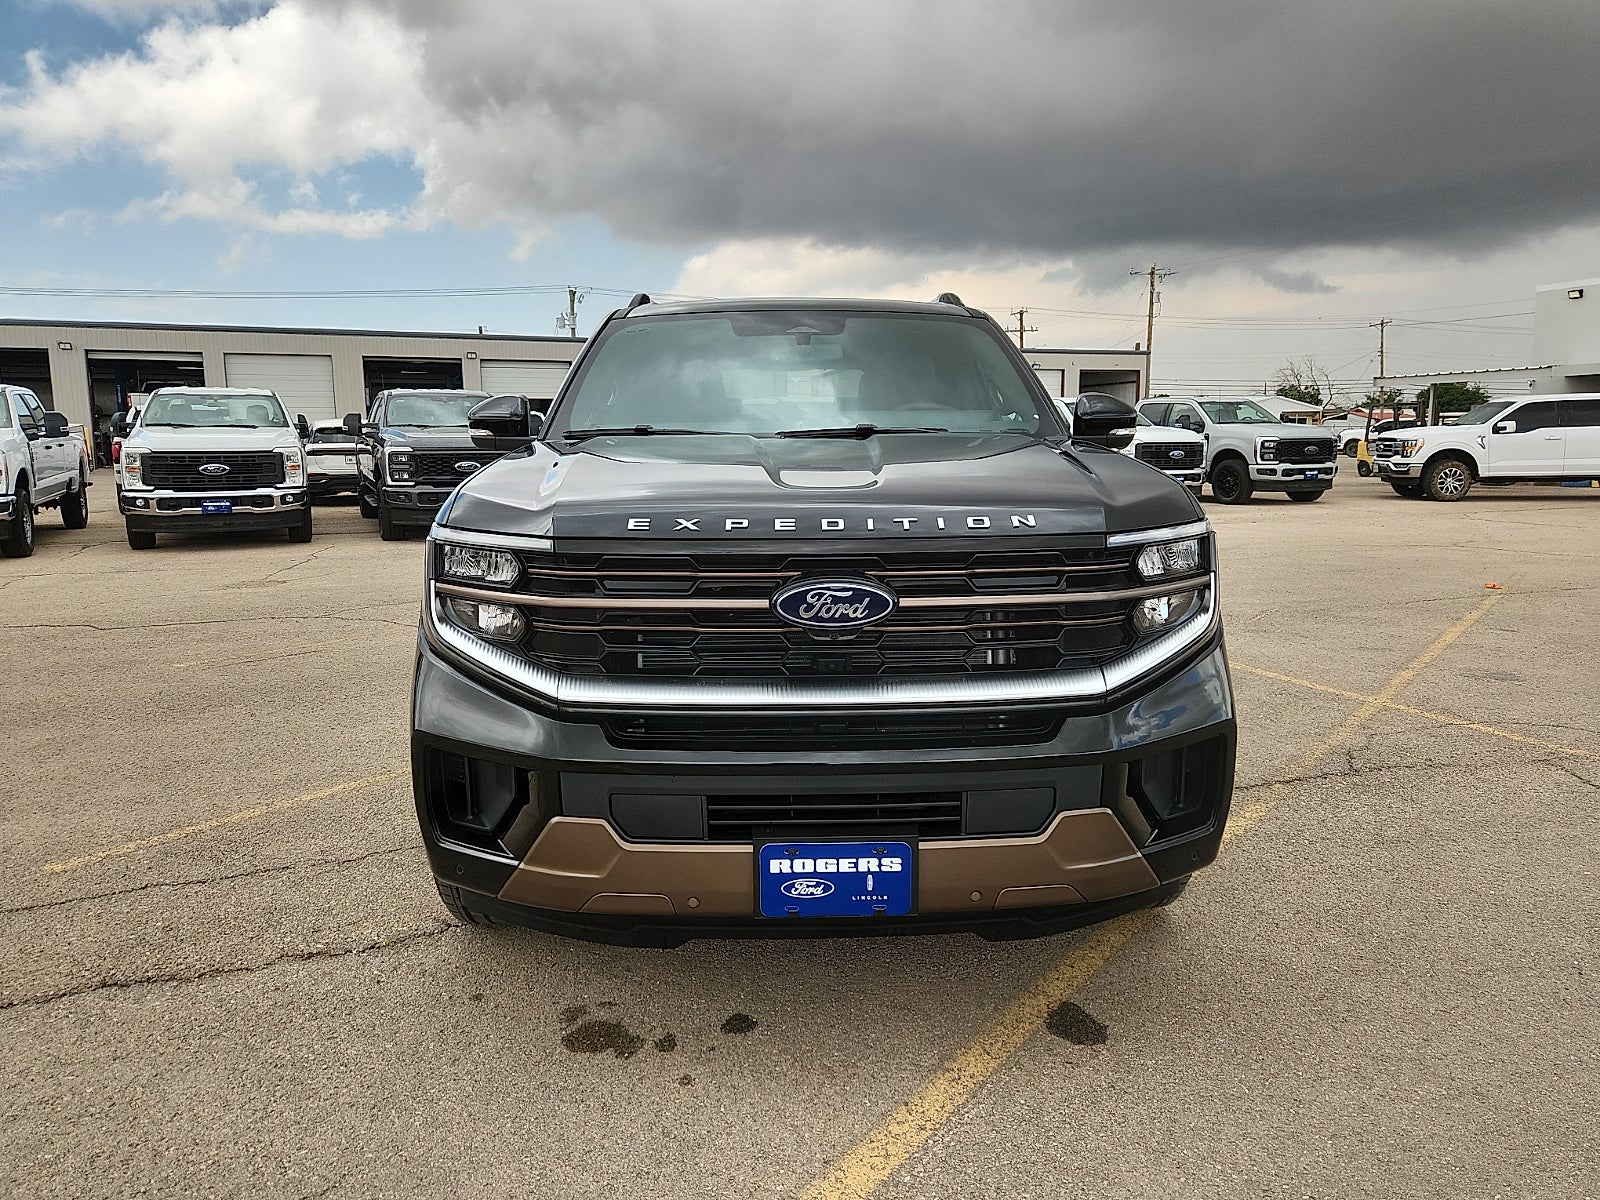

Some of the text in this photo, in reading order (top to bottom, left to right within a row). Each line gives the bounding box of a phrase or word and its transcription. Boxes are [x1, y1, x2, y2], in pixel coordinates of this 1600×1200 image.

[627, 514, 1037, 532] EXPEDITION
[799, 590, 869, 619] Ford
[769, 857, 902, 873] ROGERS
[791, 881, 825, 895] Ford
